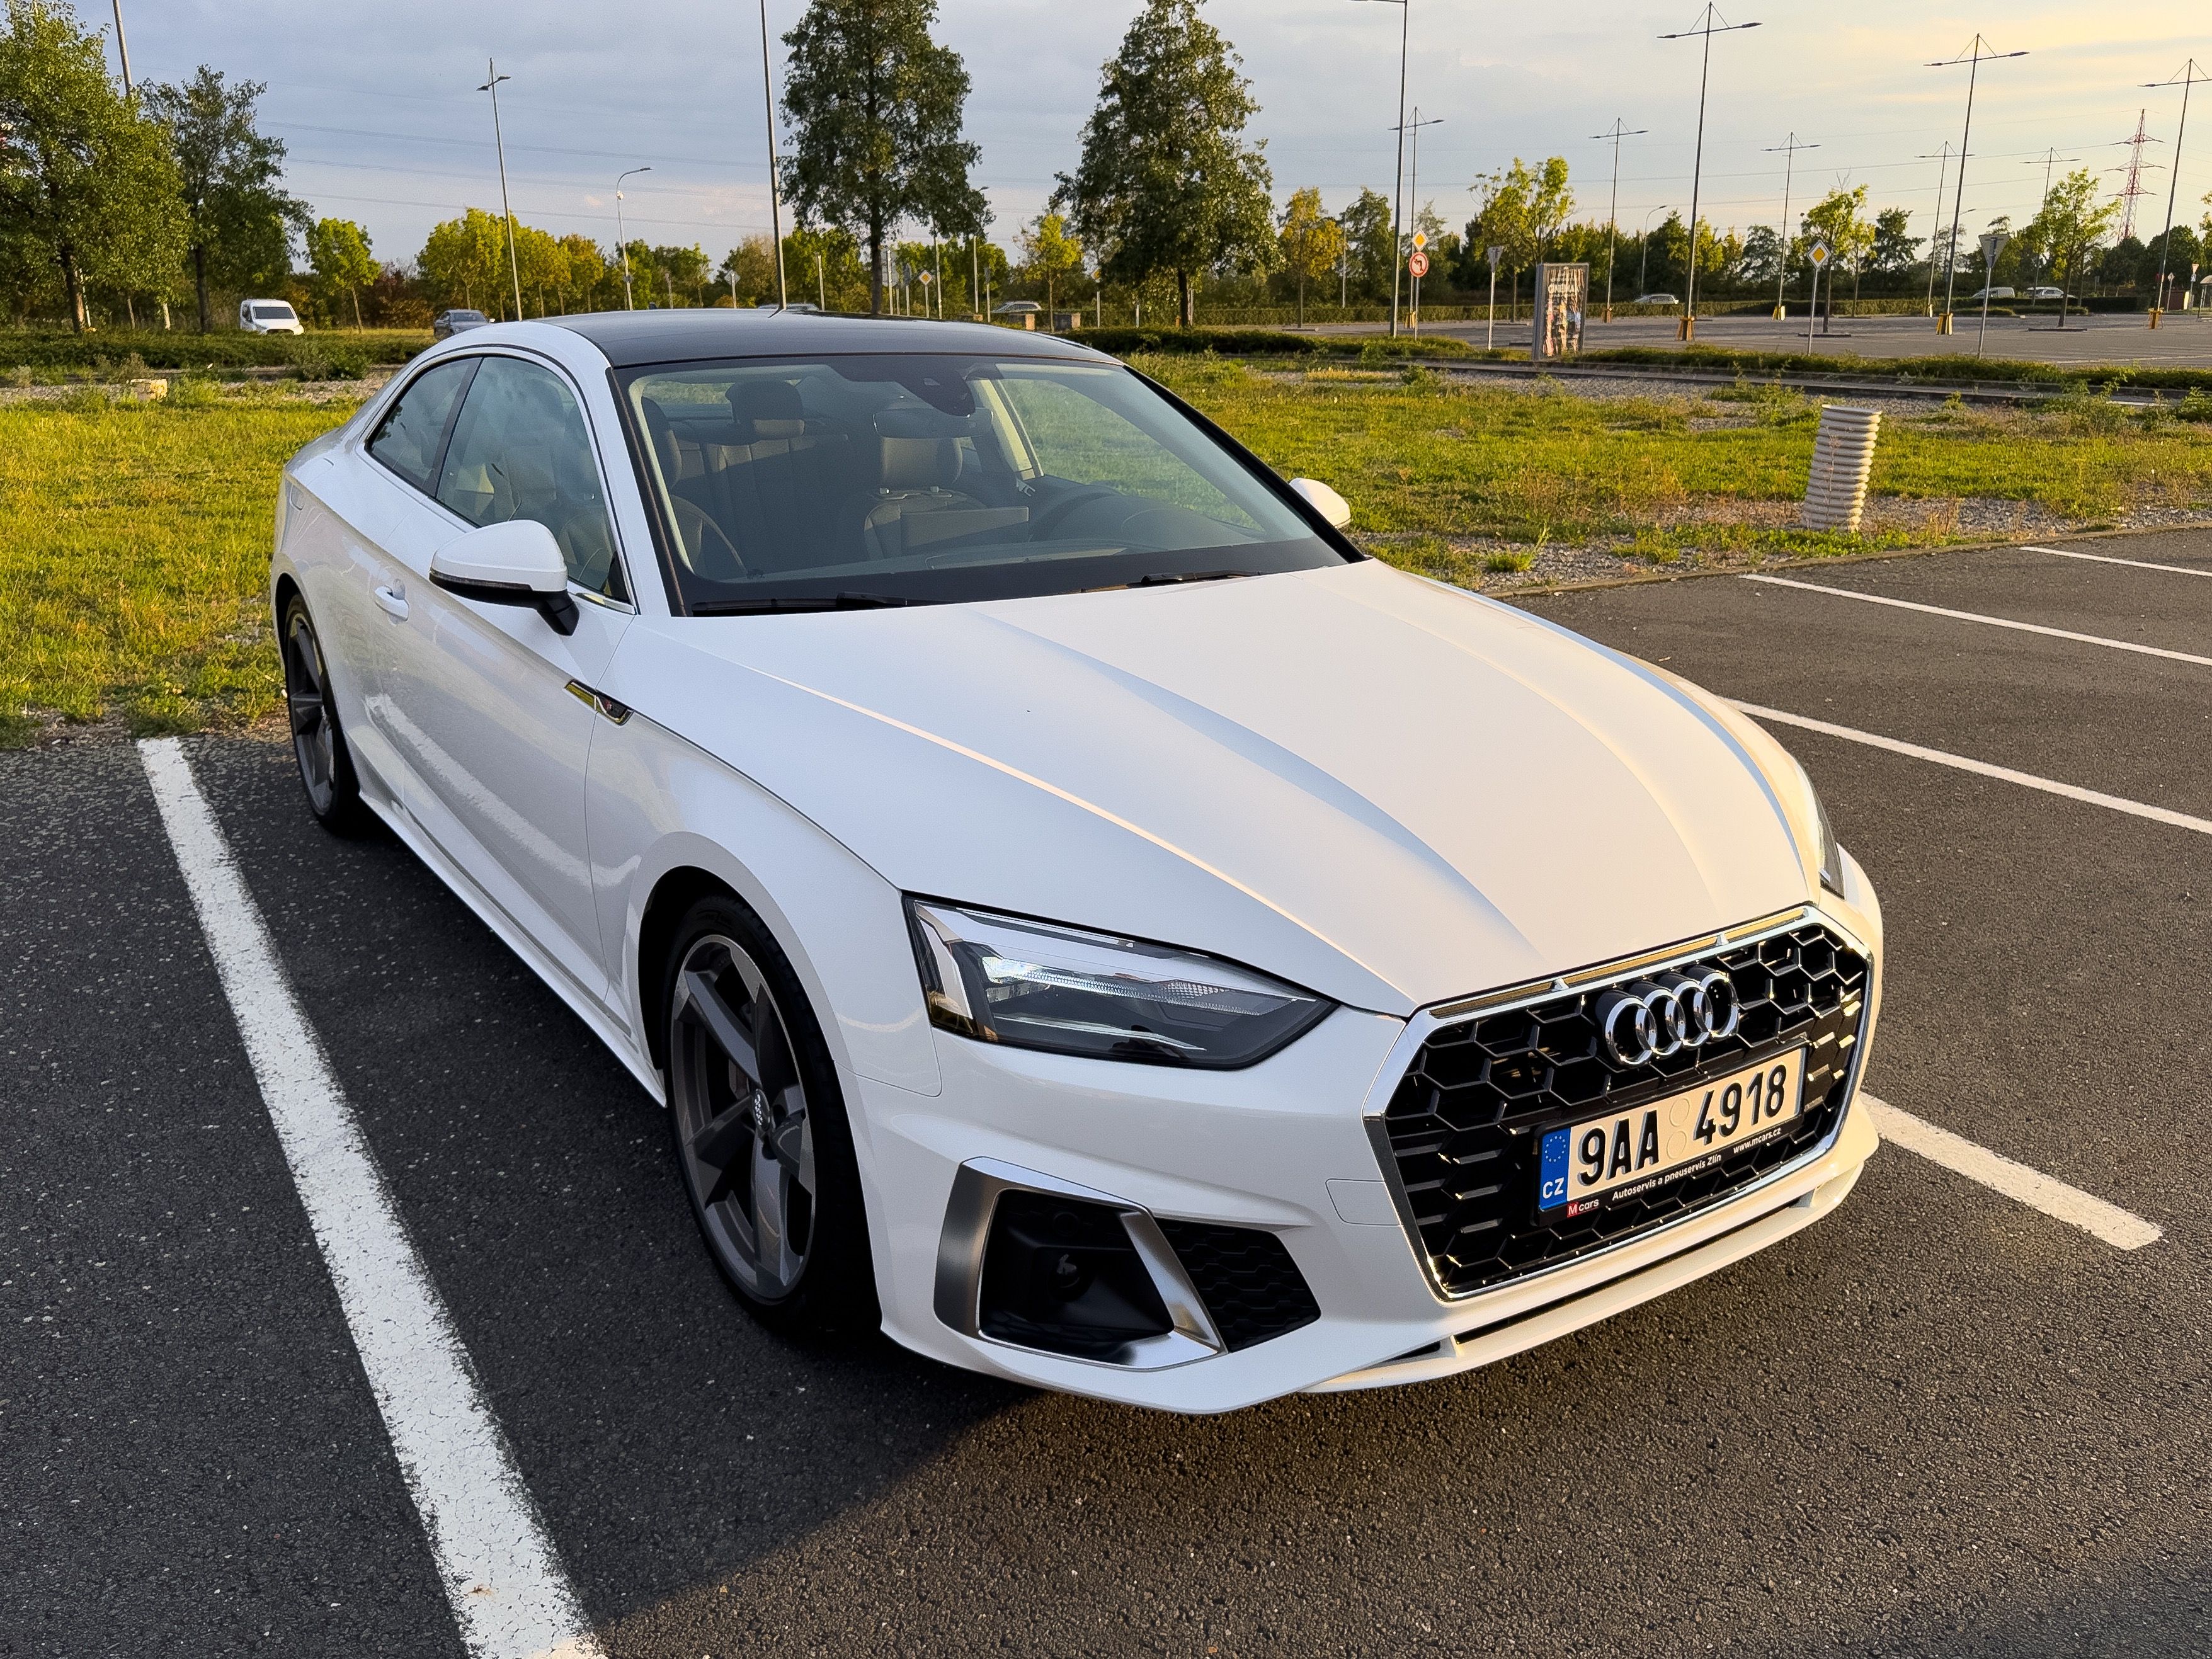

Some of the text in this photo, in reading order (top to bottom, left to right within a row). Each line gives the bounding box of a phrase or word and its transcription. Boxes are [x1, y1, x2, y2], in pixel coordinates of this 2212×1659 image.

[1577, 1064, 1786, 1186] 9AA 4918
[1733, 1127, 1781, 1154] www.mcars.cz
[1542, 1177, 1565, 1199] CZ
[1612, 1178, 1656, 1200] Autoservis
[1664, 1160, 1706, 1184] pneuservis
